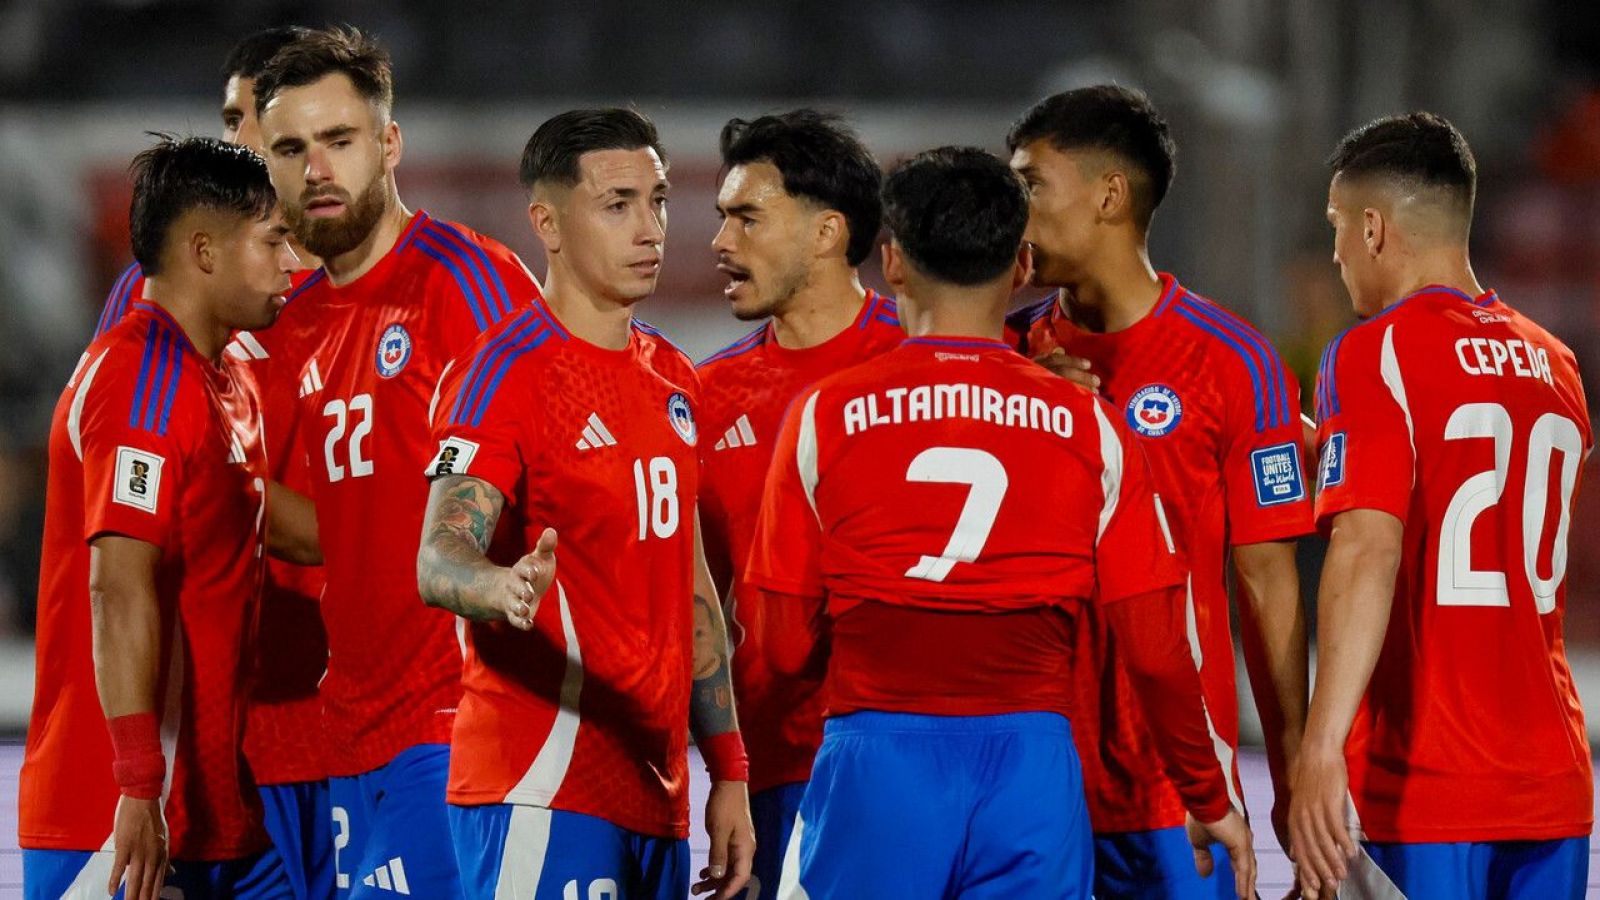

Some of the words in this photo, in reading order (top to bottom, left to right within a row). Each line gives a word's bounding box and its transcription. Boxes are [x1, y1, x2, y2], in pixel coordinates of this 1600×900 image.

[1454, 337, 1554, 385] CEPEDA
[323, 393, 374, 483] 22
[844, 383, 1074, 439] ALTAMIRANO
[1261, 452, 1291, 465] FOOTBALL
[1263, 461, 1293, 476] UNITES
[633, 456, 680, 541] 18
[904, 446, 1009, 582] 7
[1437, 402, 1582, 614] 20
